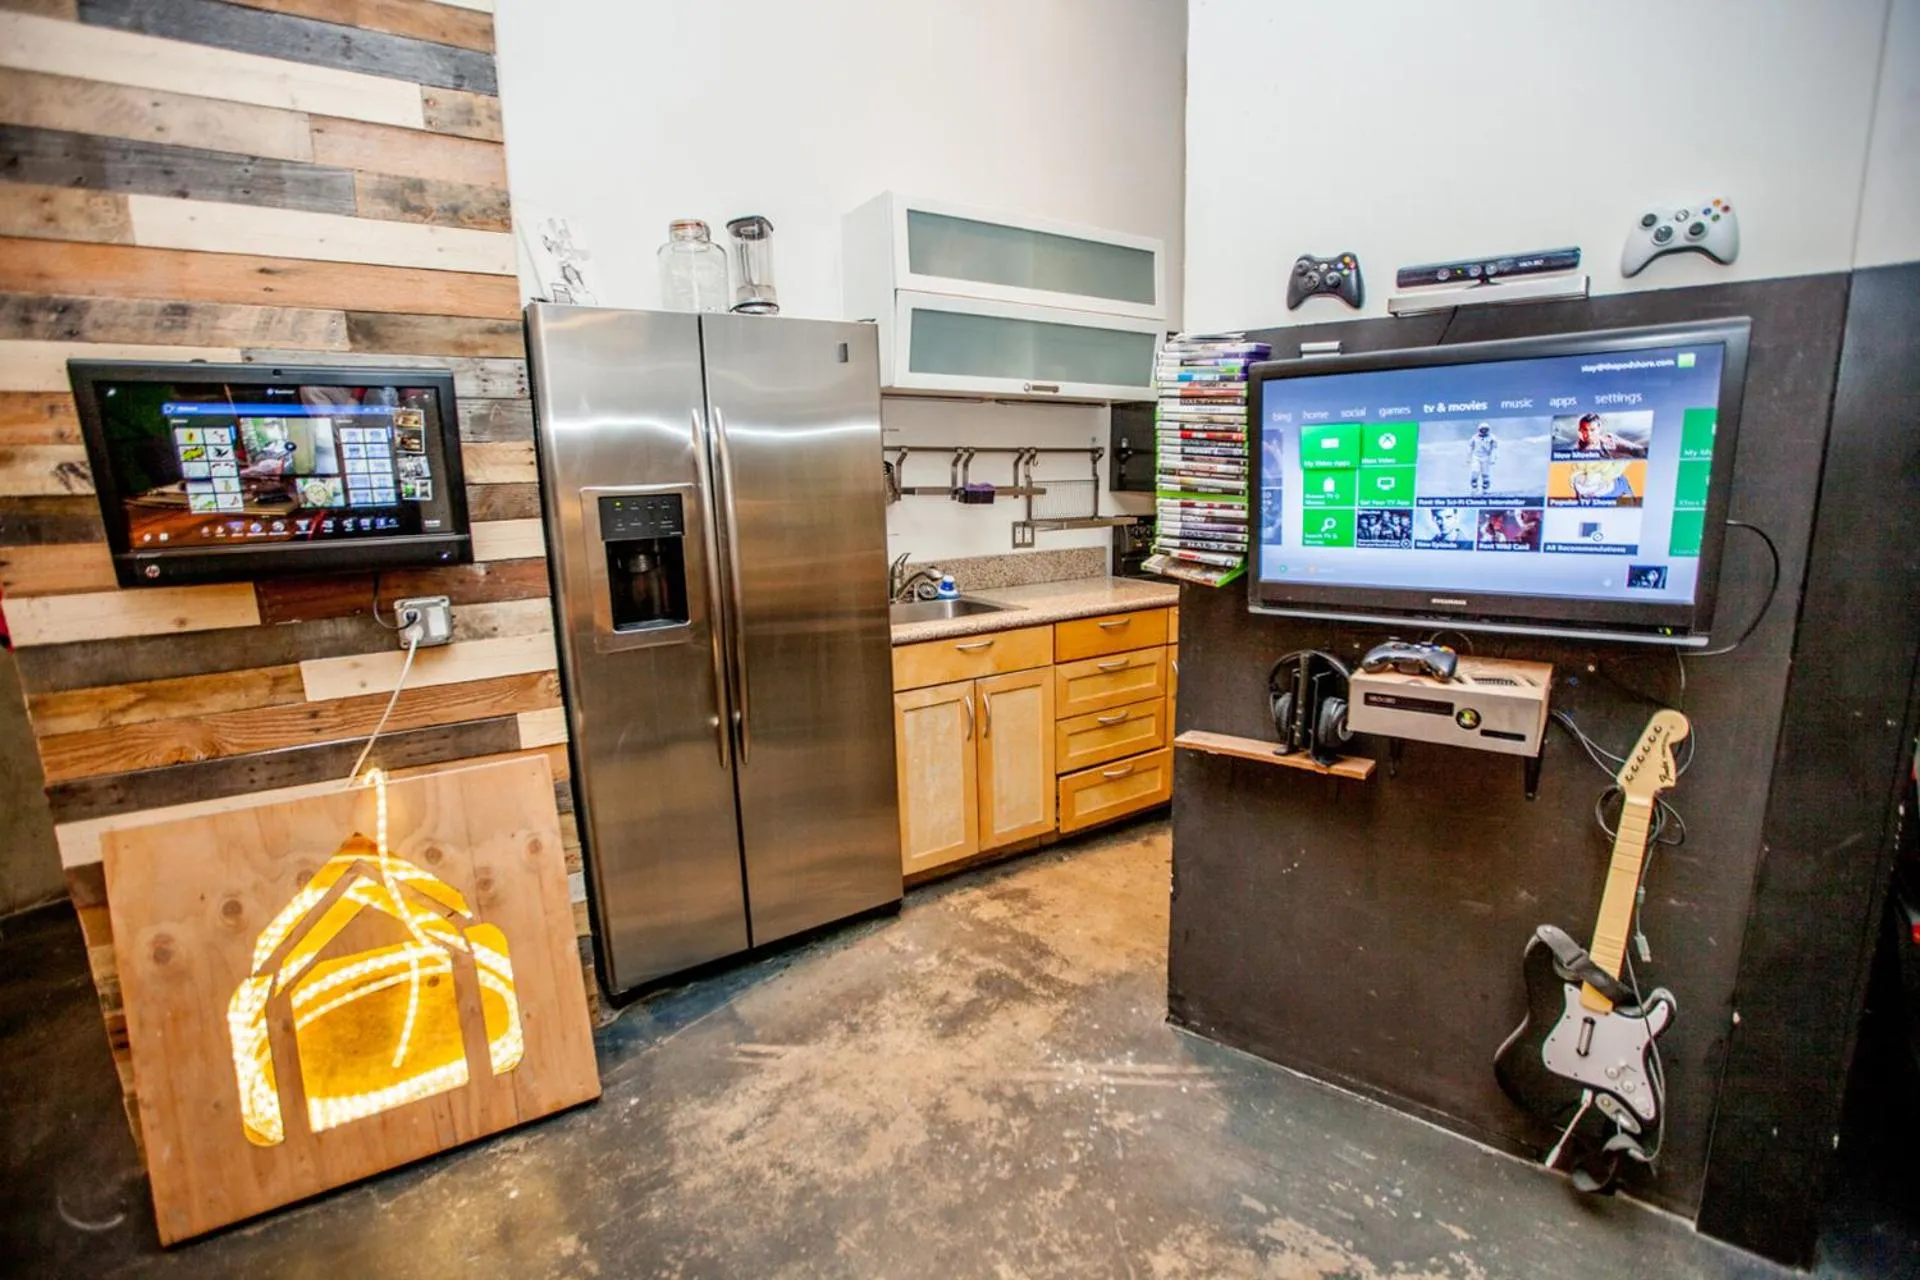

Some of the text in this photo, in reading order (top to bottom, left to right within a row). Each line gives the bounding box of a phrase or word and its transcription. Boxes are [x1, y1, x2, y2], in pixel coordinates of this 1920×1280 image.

[1501, 398, 1534, 410] music
[1549, 395, 1577, 409] apps
[1594, 392, 1643, 406] settings
[1340, 406, 1367, 418] social
[1378, 405, 1412, 418] games
[1423, 400, 1488, 414] tv & movies
[1272, 411, 1293, 423] bing
[1303, 409, 1330, 420] home
[1580, 498, 1591, 506] TV
